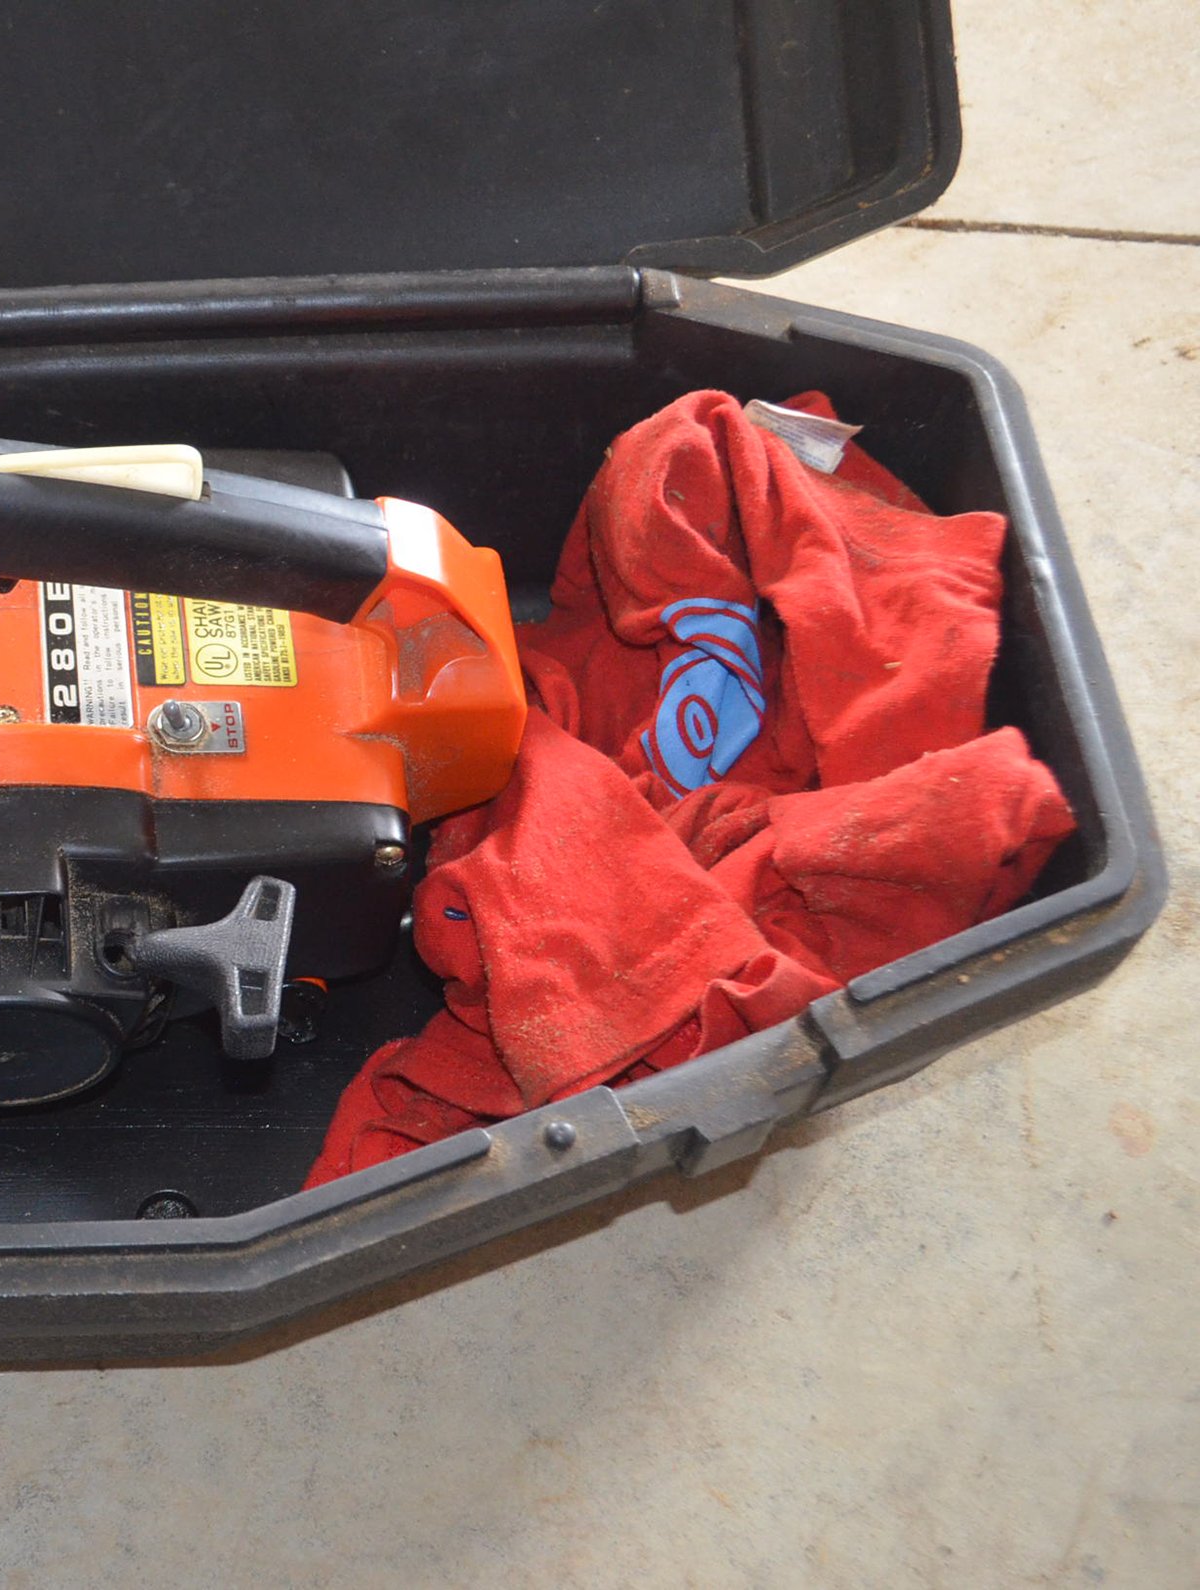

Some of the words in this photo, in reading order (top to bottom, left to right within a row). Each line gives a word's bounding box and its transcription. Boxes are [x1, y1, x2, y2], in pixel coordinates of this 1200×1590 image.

[80, 608, 88, 630] follow
[100, 594, 110, 639] instructions
[112, 601, 120, 632] personal
[134, 593, 153, 655] CAUTION
[192, 601, 209, 638] CHAI
[207, 603, 224, 638] SAW
[224, 610, 236, 638] 87G1
[247, 607, 255, 620] STAN
[238, 615, 248, 648] ACCORDANCE
[249, 625, 258, 649] NATIONAL
[257, 615, 269, 657] SPECIFICATIONS
[268, 628, 277, 652] POWERED
[83, 652, 91, 670] Read
[104, 647, 112, 670] follow
[115, 643, 123, 670] serious
[204, 650, 231, 670] UL
[253, 653, 261, 681] AMERICAN
[271, 656, 281, 682] GASOLINE
[107, 679, 114, 687] to
[244, 662, 253, 681] LISTED
[262, 662, 272, 681] SAFETY
[97, 680, 106, 725] precautions
[108, 696, 116, 724] Failure
[119, 701, 127, 725] result
[224, 703, 239, 748] STOP
